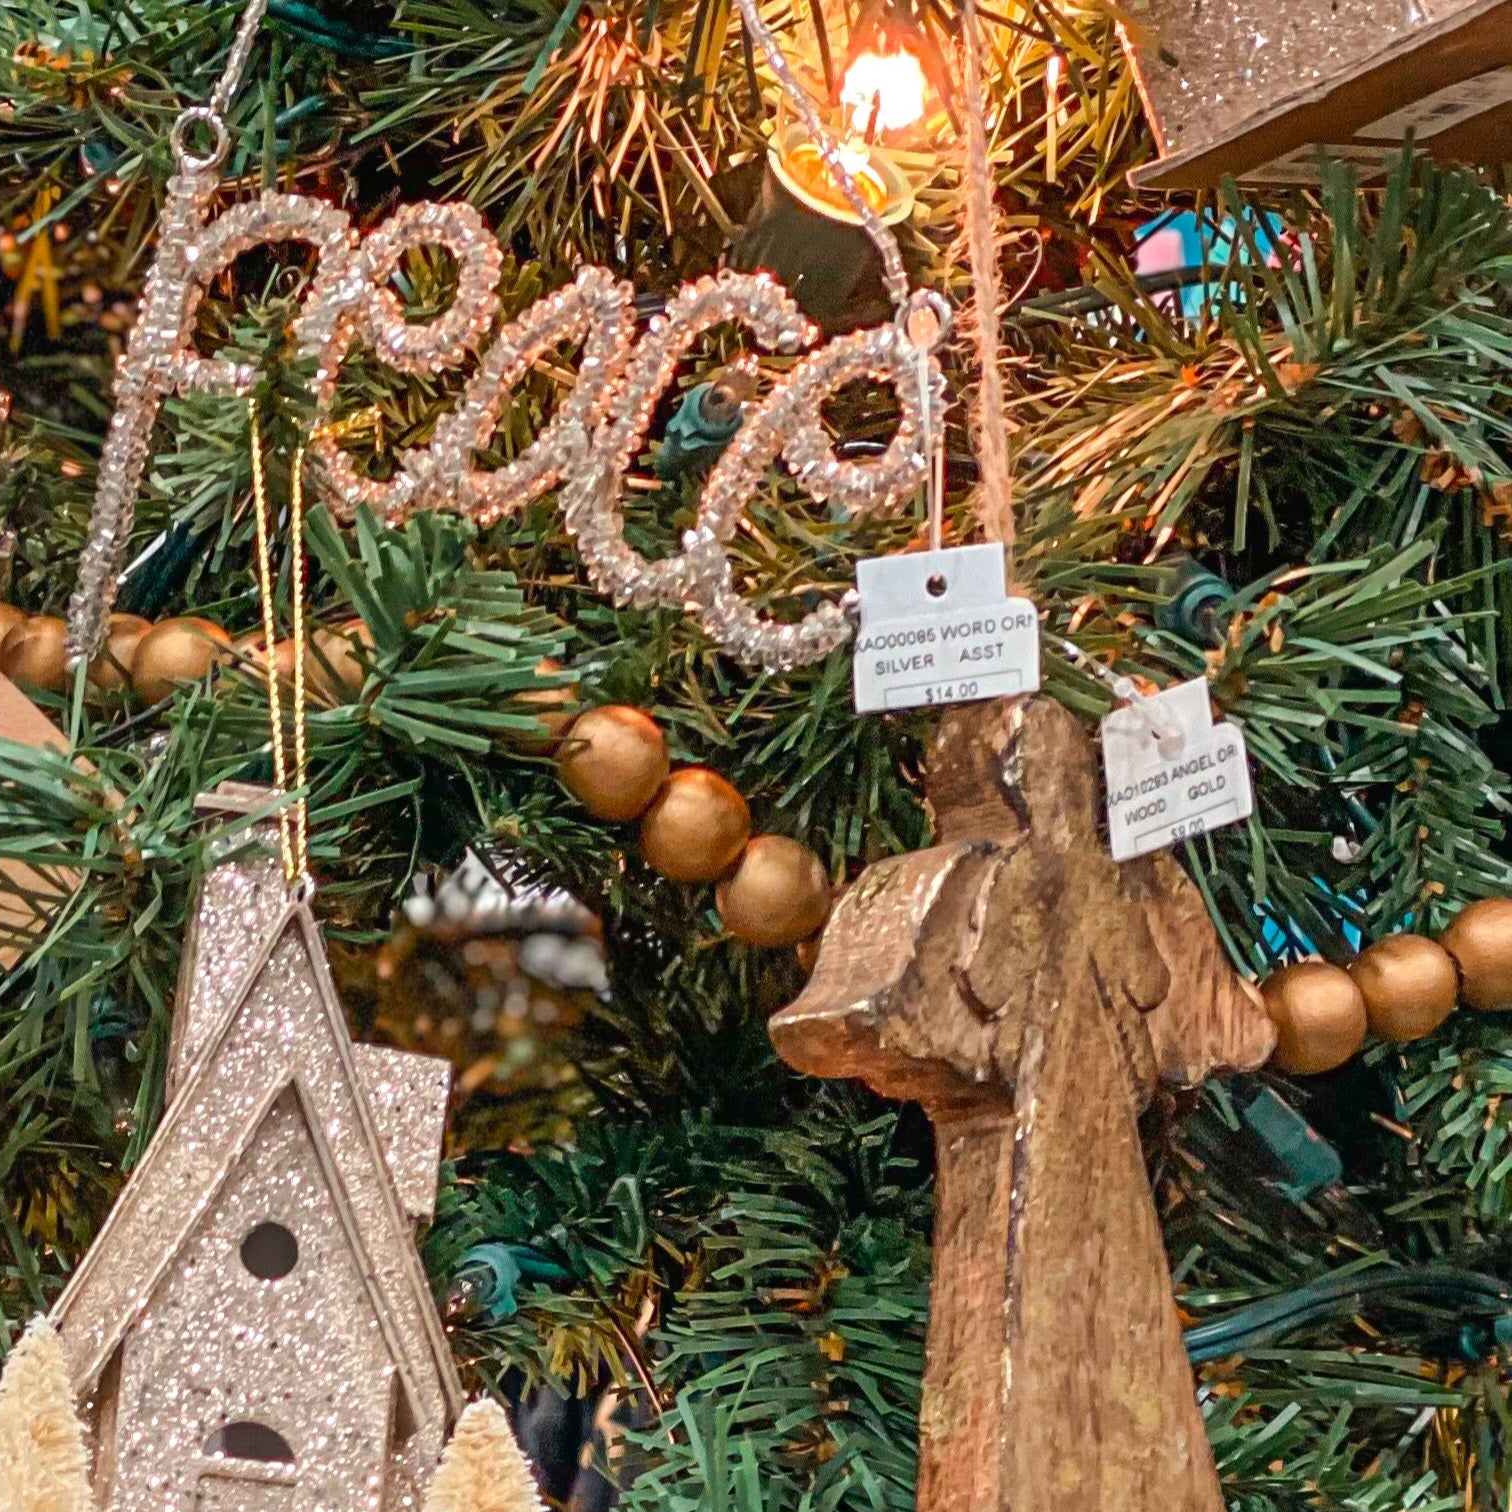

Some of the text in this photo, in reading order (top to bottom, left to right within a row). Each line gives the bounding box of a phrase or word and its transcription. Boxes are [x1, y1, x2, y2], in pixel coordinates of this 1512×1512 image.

[941, 619, 996, 641] WORD
[875, 643, 1004, 676] SILVER ASST
[925, 681, 978, 703] $14.00
[1171, 754, 1215, 781] ANGEL
[1125, 775, 1226, 826] WOOD GOLD
